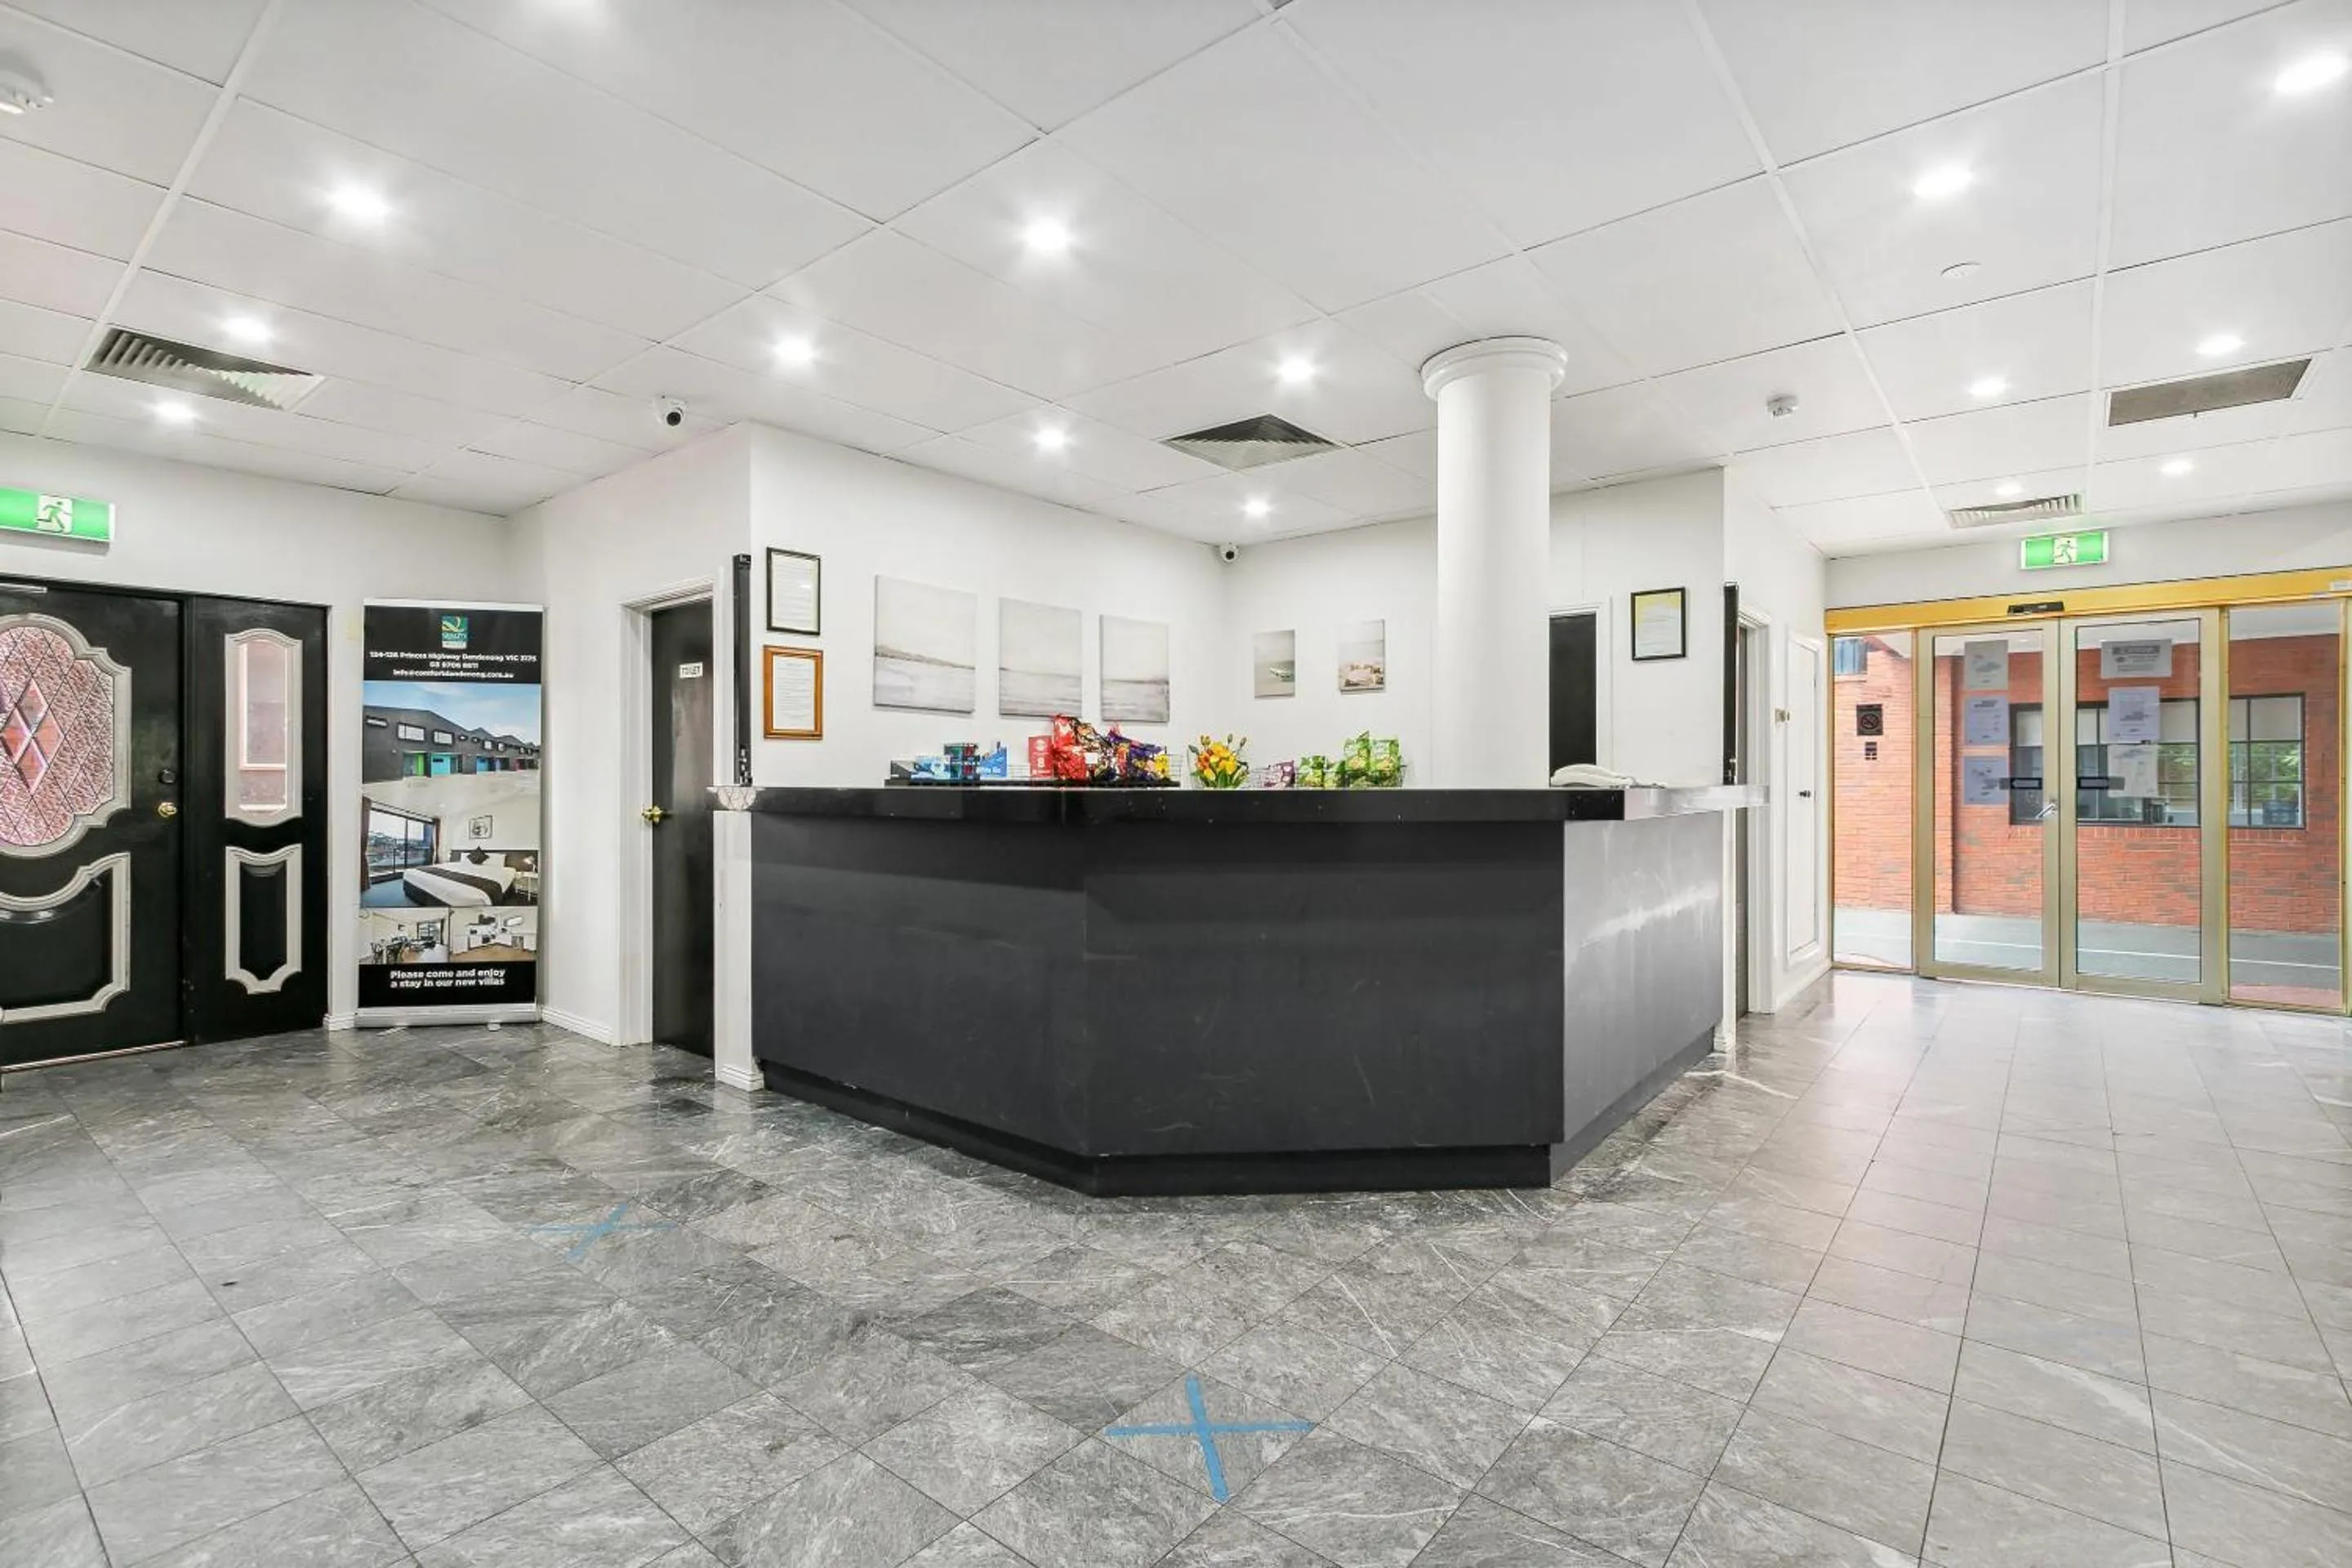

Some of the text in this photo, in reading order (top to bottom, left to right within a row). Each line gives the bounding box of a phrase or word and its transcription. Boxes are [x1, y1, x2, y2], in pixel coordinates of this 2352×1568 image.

[428, 653, 461, 661] Highway
[462, 653, 504, 662] Dandenong
[390, 970, 424, 979] Please
[456, 969, 476, 978] and
[478, 969, 506, 978] enjoy
[399, 980, 422, 989] stay
[423, 979, 434, 987] in
[479, 978, 505, 986] villas
